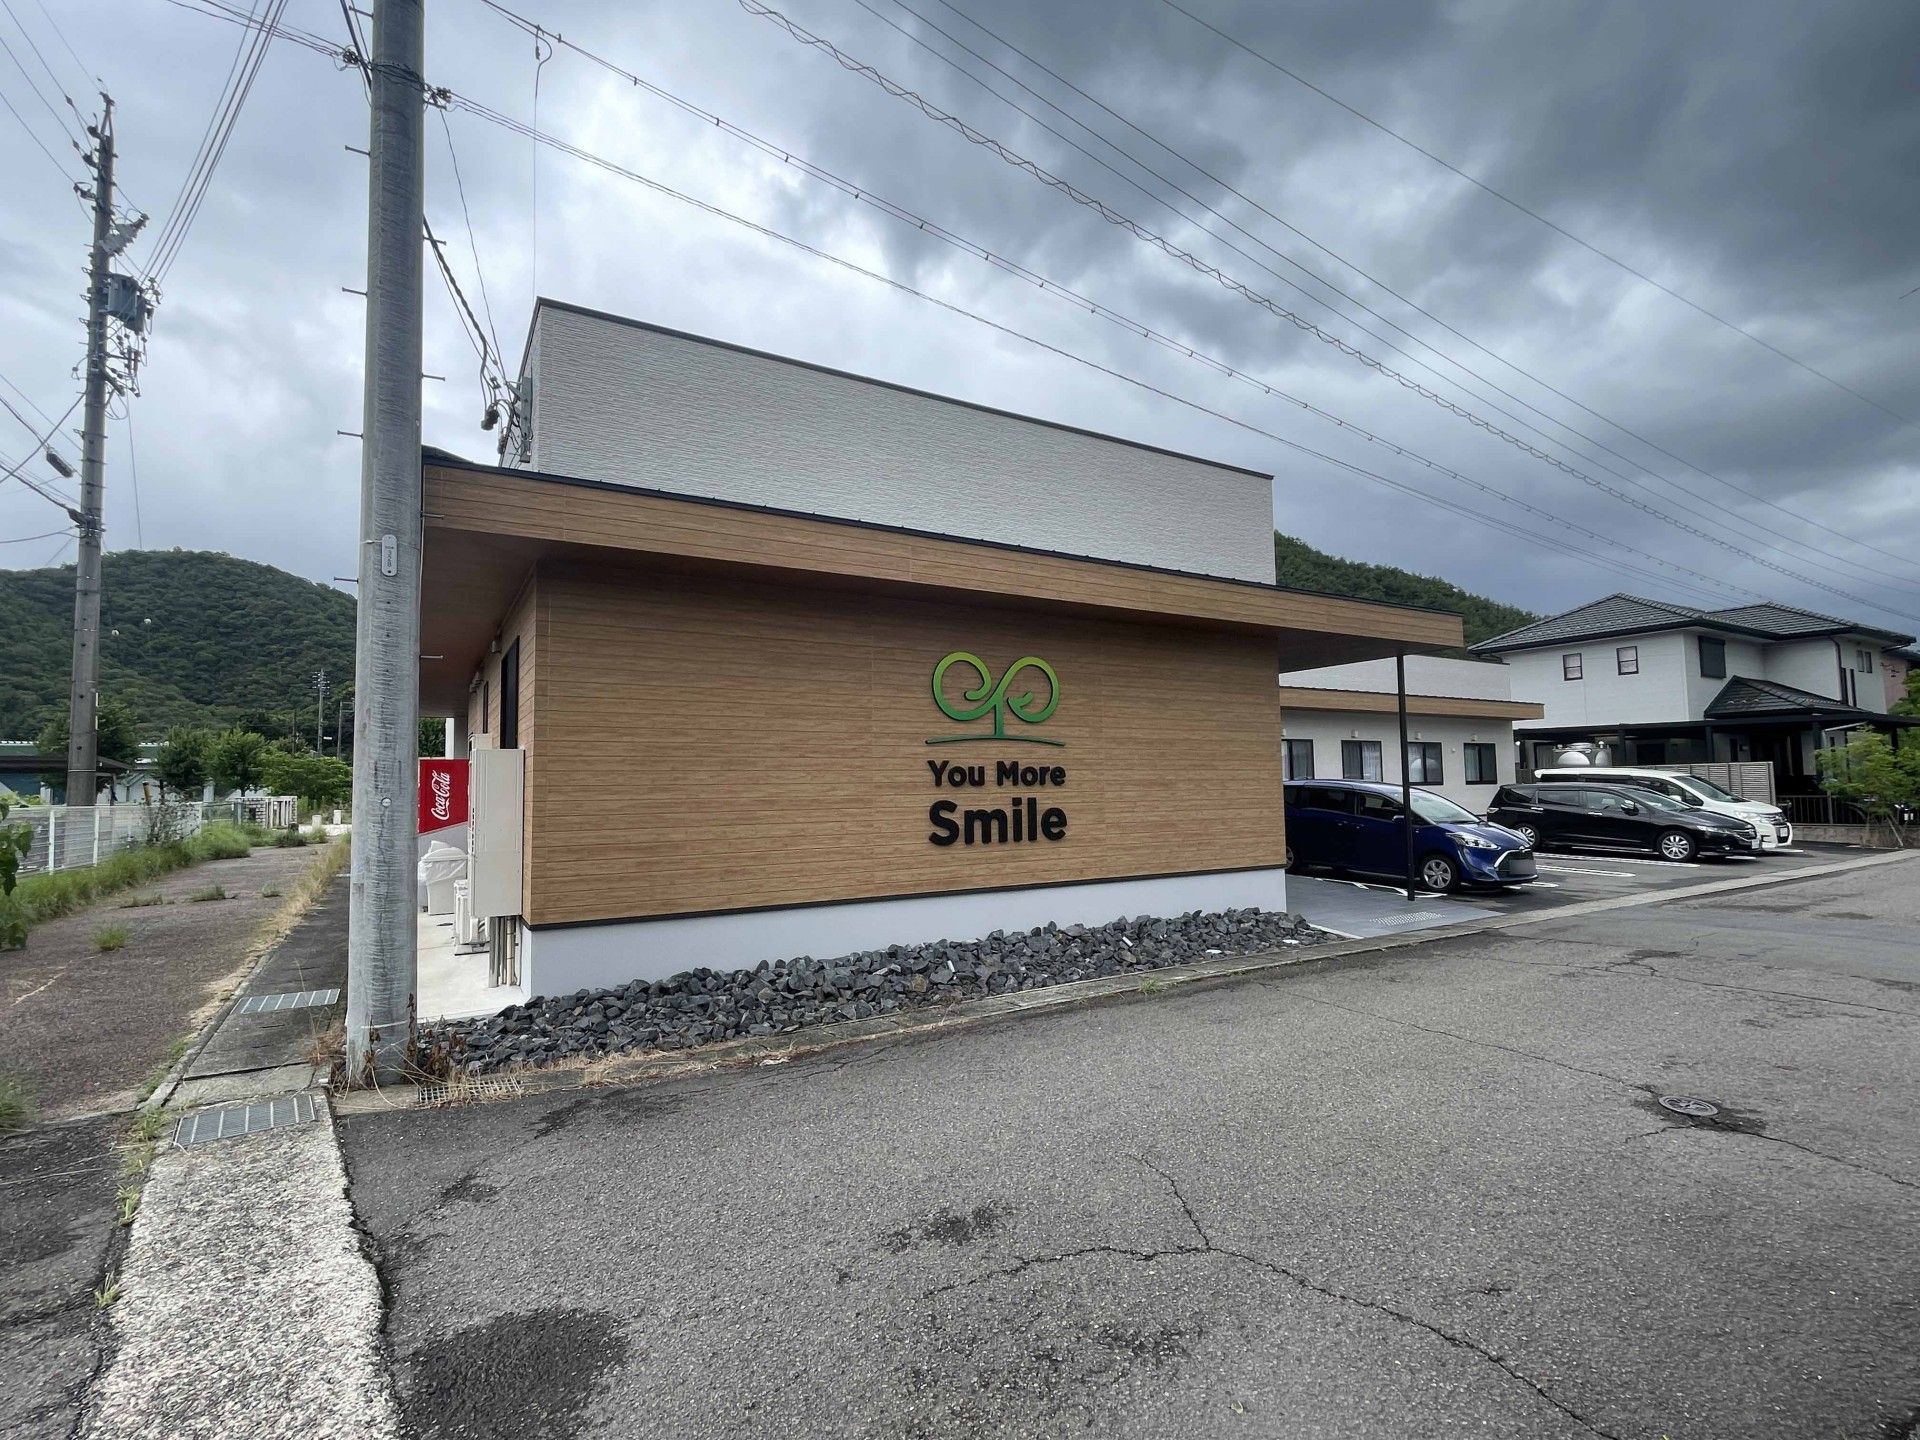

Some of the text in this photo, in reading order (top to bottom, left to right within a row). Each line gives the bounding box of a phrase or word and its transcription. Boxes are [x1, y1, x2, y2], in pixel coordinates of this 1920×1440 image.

[927, 760, 1067, 787] You More
[928, 797, 1068, 846] Smile
